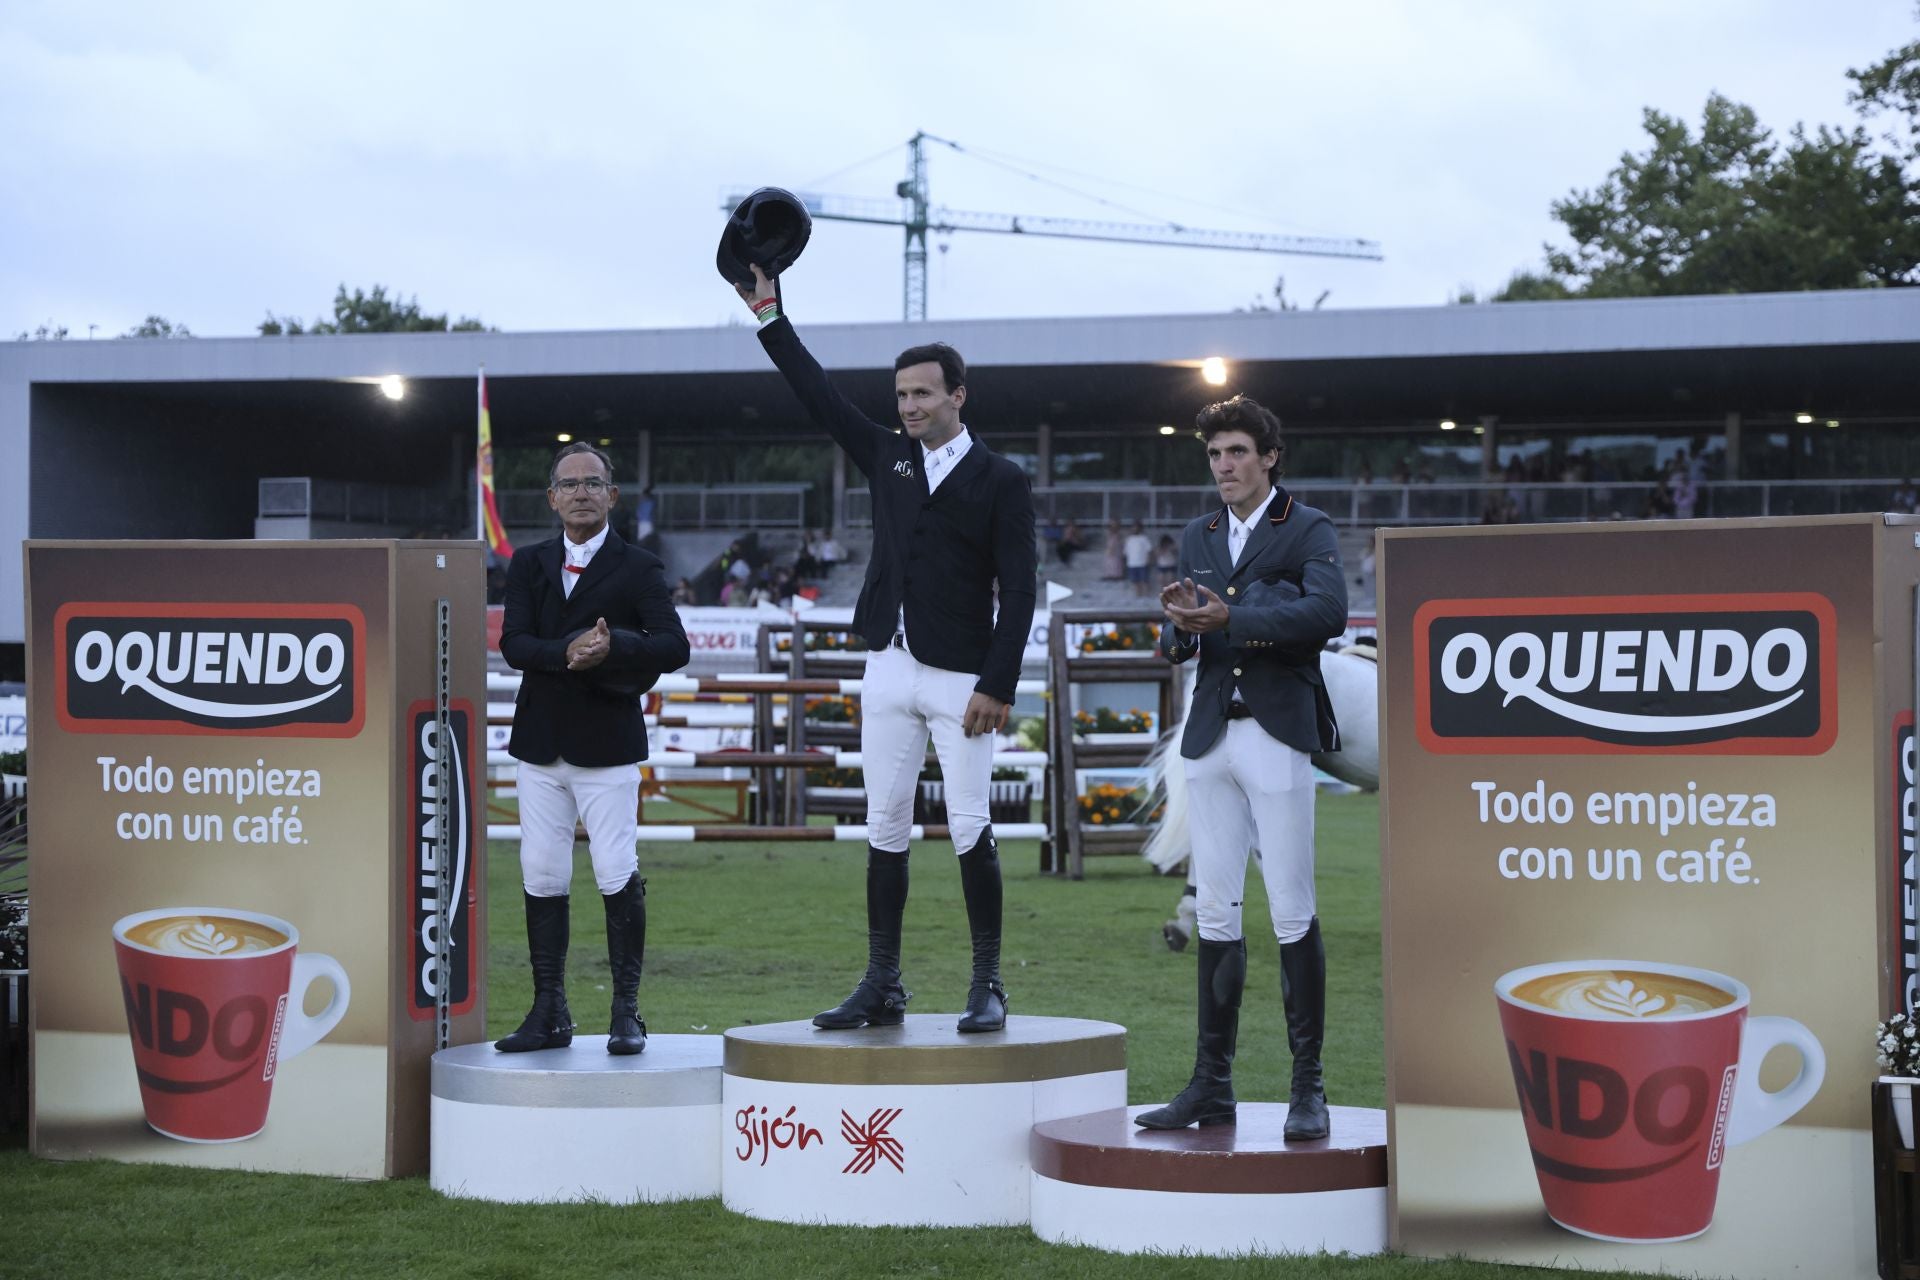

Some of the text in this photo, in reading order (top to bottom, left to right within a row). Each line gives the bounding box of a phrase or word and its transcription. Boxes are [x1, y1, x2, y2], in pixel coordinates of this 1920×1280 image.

[74, 630, 345, 696] OQUENDO
[1440, 627, 1808, 708] OQUENDO
[97, 756, 322, 804] Todo empieza
[1471, 779, 1777, 836] Todo empieza
[116, 806, 309, 845] con un café.
[1498, 837, 1761, 885] con un café.
[265, 1001, 286, 1076] OQUENDO
[735, 1104, 824, 1167] gijón
[1710, 1071, 1734, 1163] OQUENDO
